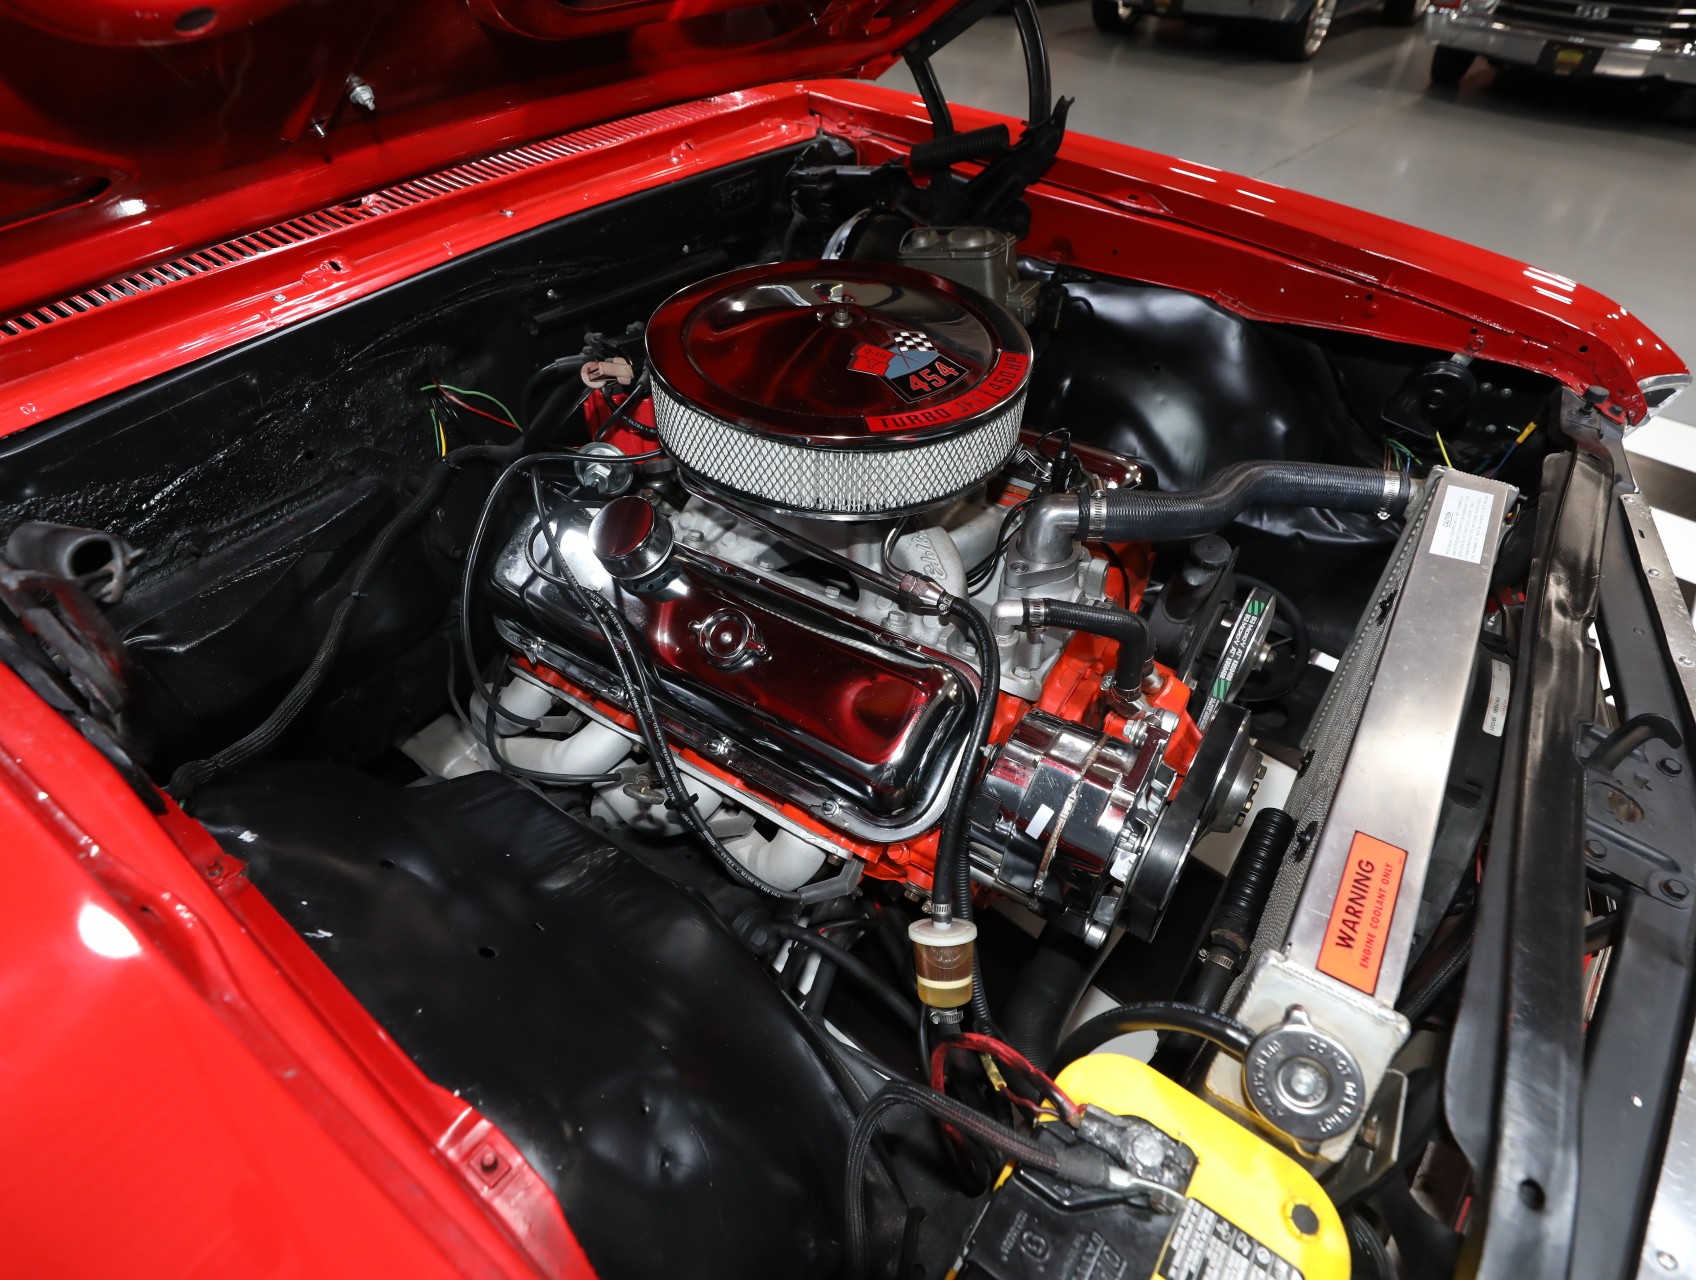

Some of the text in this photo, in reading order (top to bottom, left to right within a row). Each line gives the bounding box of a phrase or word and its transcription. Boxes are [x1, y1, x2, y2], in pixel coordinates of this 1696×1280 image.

[908, 361, 960, 392] 454
[989, 371, 1018, 391] 450
[1006, 356, 1023, 369] HP
[651, 722, 664, 740] ULTRA
[661, 747, 672, 764] MADE
[670, 771, 679, 782] THE
[720, 852, 735, 867] ULTRA
[740, 871, 754, 883] MADE
[760, 885, 771, 893] THE
[1335, 859, 1375, 950] WARNING
[1359, 862, 1394, 968] ENGINE COOLANT ONLY
